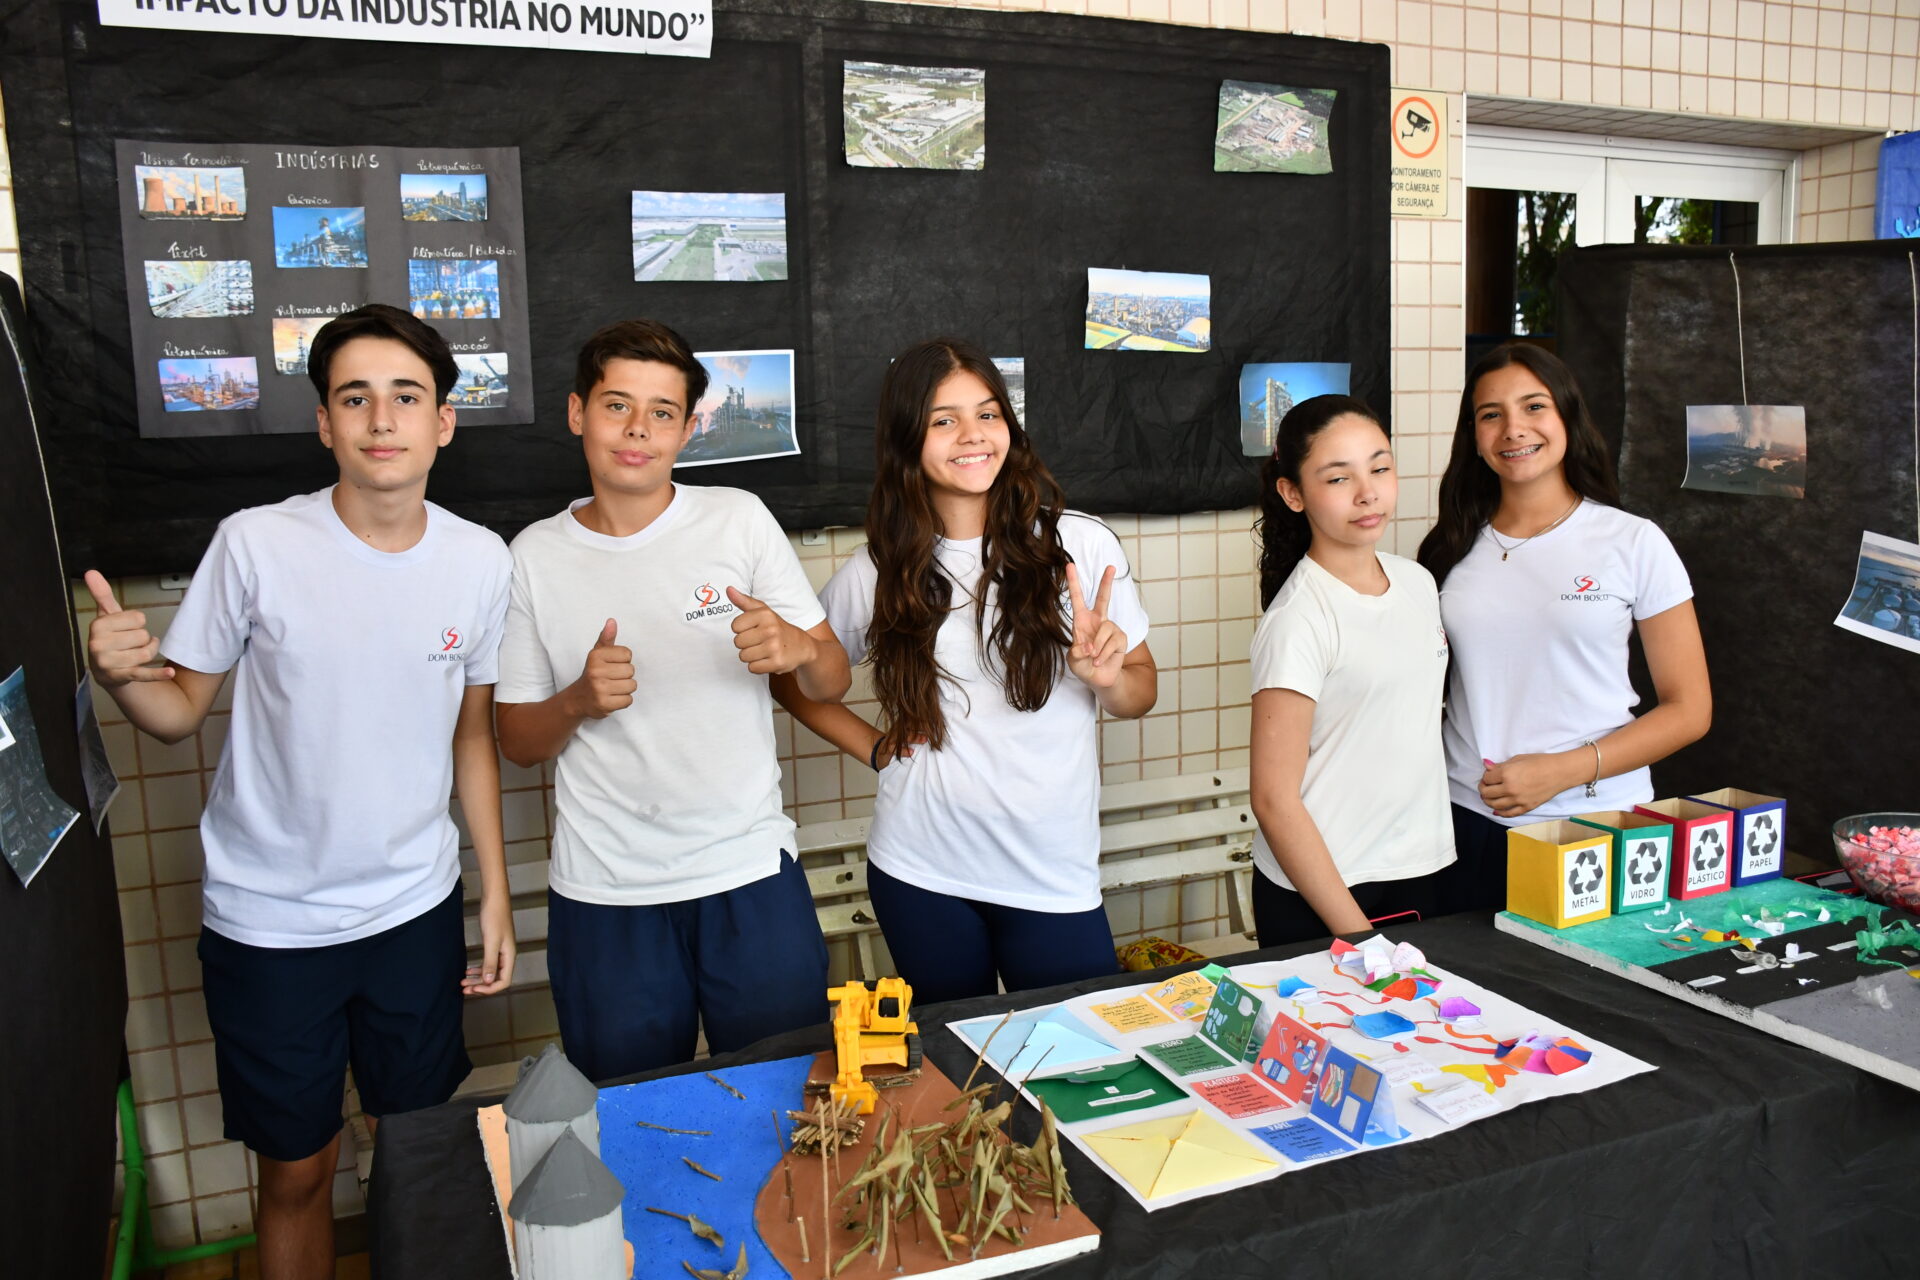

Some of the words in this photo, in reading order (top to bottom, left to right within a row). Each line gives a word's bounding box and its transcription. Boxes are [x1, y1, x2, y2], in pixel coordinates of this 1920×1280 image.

[297, 0, 344, 21] DA
[528, 2, 571, 33] NO
[275, 150, 380, 170] INDÚSTRIAS
[1431, 184, 1440, 193] DE
[1396, 197, 1434, 208] SEGURANÇA
[325, 304, 339, 315] de
[686, 608, 706, 621] DOM
[706, 603, 734, 616] BOSCO
[427, 653, 448, 662] DOM
[1749, 857, 1773, 869] PAPEL
[1688, 870, 1725, 886] PLÁSTICO
[1630, 888, 1656, 900] VIDRO
[1572, 895, 1600, 909] METAL
